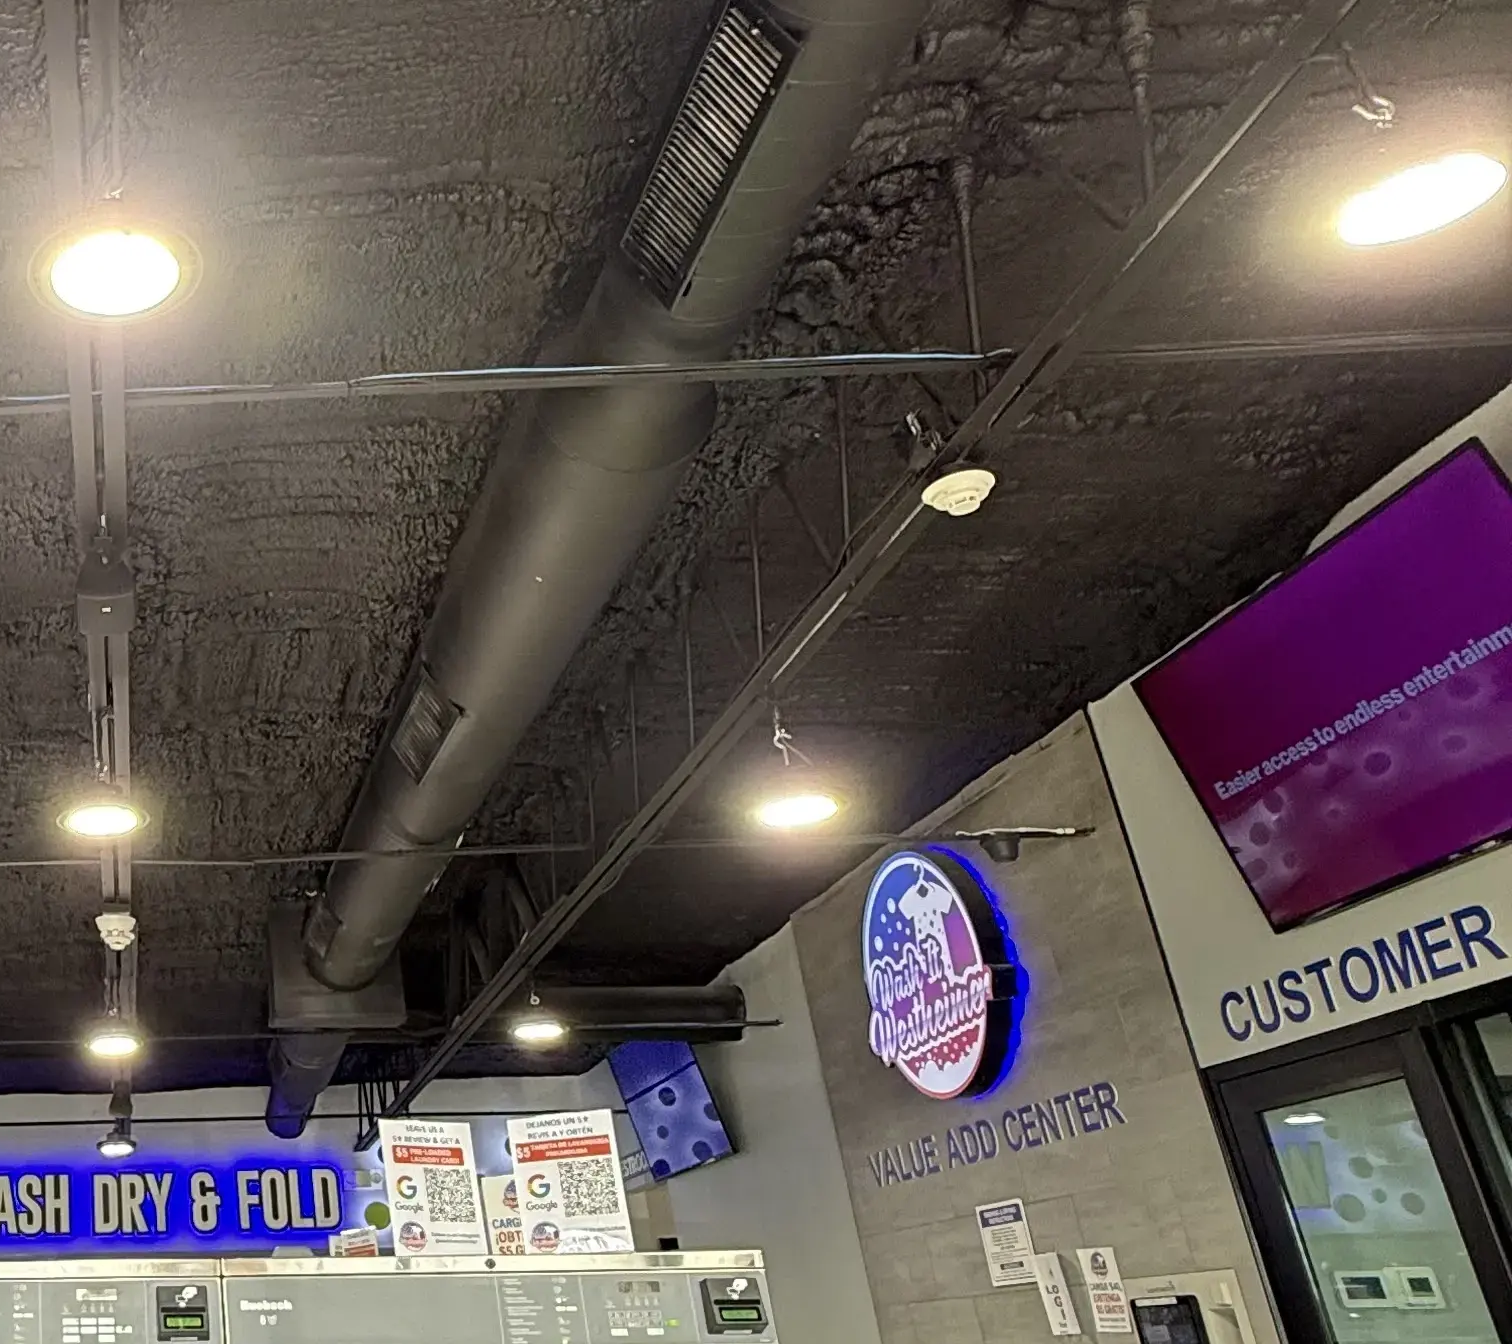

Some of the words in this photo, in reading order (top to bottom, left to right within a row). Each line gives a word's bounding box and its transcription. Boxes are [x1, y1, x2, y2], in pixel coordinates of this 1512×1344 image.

[1213, 765, 1263, 801] Easier
[1261, 736, 1317, 777] access
[1312, 726, 1336, 746] to
[1335, 687, 1405, 735] endless
[872, 955, 924, 1009] Wash
[923, 938, 944, 984] It
[1220, 904, 1510, 1042] CUSTOMER
[871, 970, 991, 1059] Westheimer
[869, 1135, 943, 1187] VALUE
[947, 1119, 1000, 1169] ADD
[1003, 1081, 1128, 1152] CENTER
[93, 1172, 173, 1234] DRY
[191, 1171, 220, 1232] &
[236, 1168, 341, 1230] FOLD
[395, 1201, 424, 1214] Google
[492, 1218, 522, 1230] CARG
[526, 1200, 558, 1213] Google
[496, 1231, 524, 1246] ¡OBT
